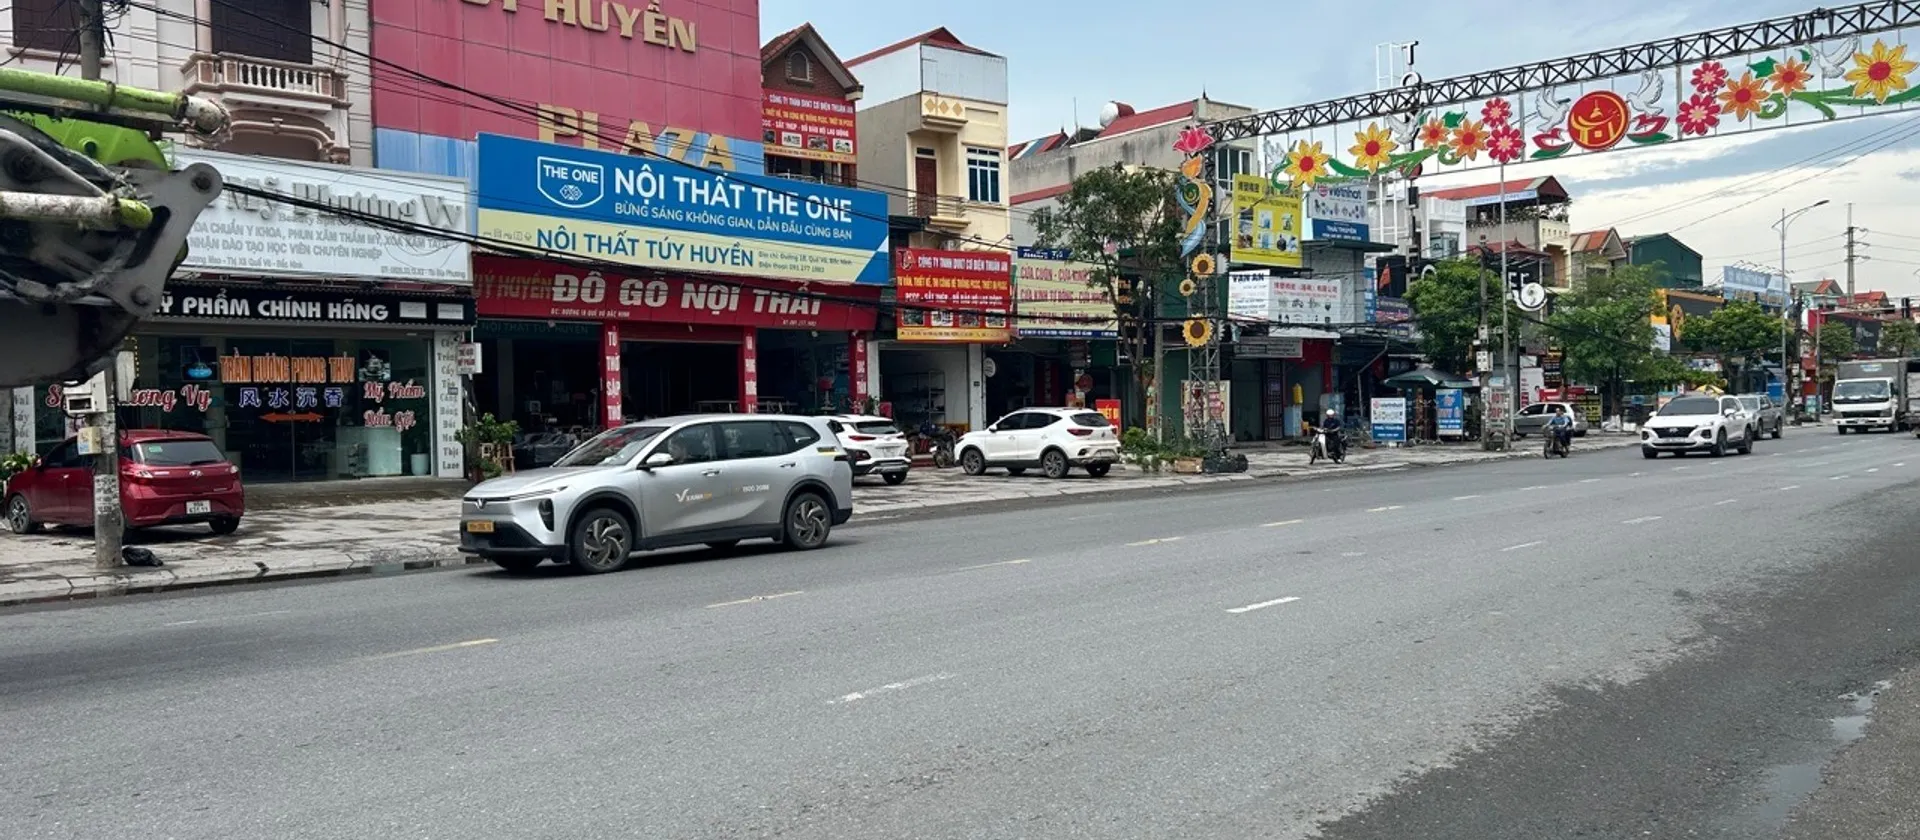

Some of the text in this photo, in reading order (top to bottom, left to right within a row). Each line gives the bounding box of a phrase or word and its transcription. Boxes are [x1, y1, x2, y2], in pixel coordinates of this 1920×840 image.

[544, 164, 598, 184] THE ONE
[615, 164, 852, 223] NỘI THẤT THE ONE
[615, 202, 853, 243] BỪNG SÁNG KHÔNG GIAN, DẪN ĐẦU CÙNG BẠN
[583, 230, 640, 257] THẤT
[646, 236, 685, 260] TÚY
[691, 241, 753, 267] HUYỀN
[156, 288, 389, 321] Ỹ PHẨM CHÍNH HÃNG
[681, 280, 741, 316] NỘI
[220, 347, 355, 384] TRẦM HƯƠNG PHONG THỦY
[182, 384, 212, 412] Vy
